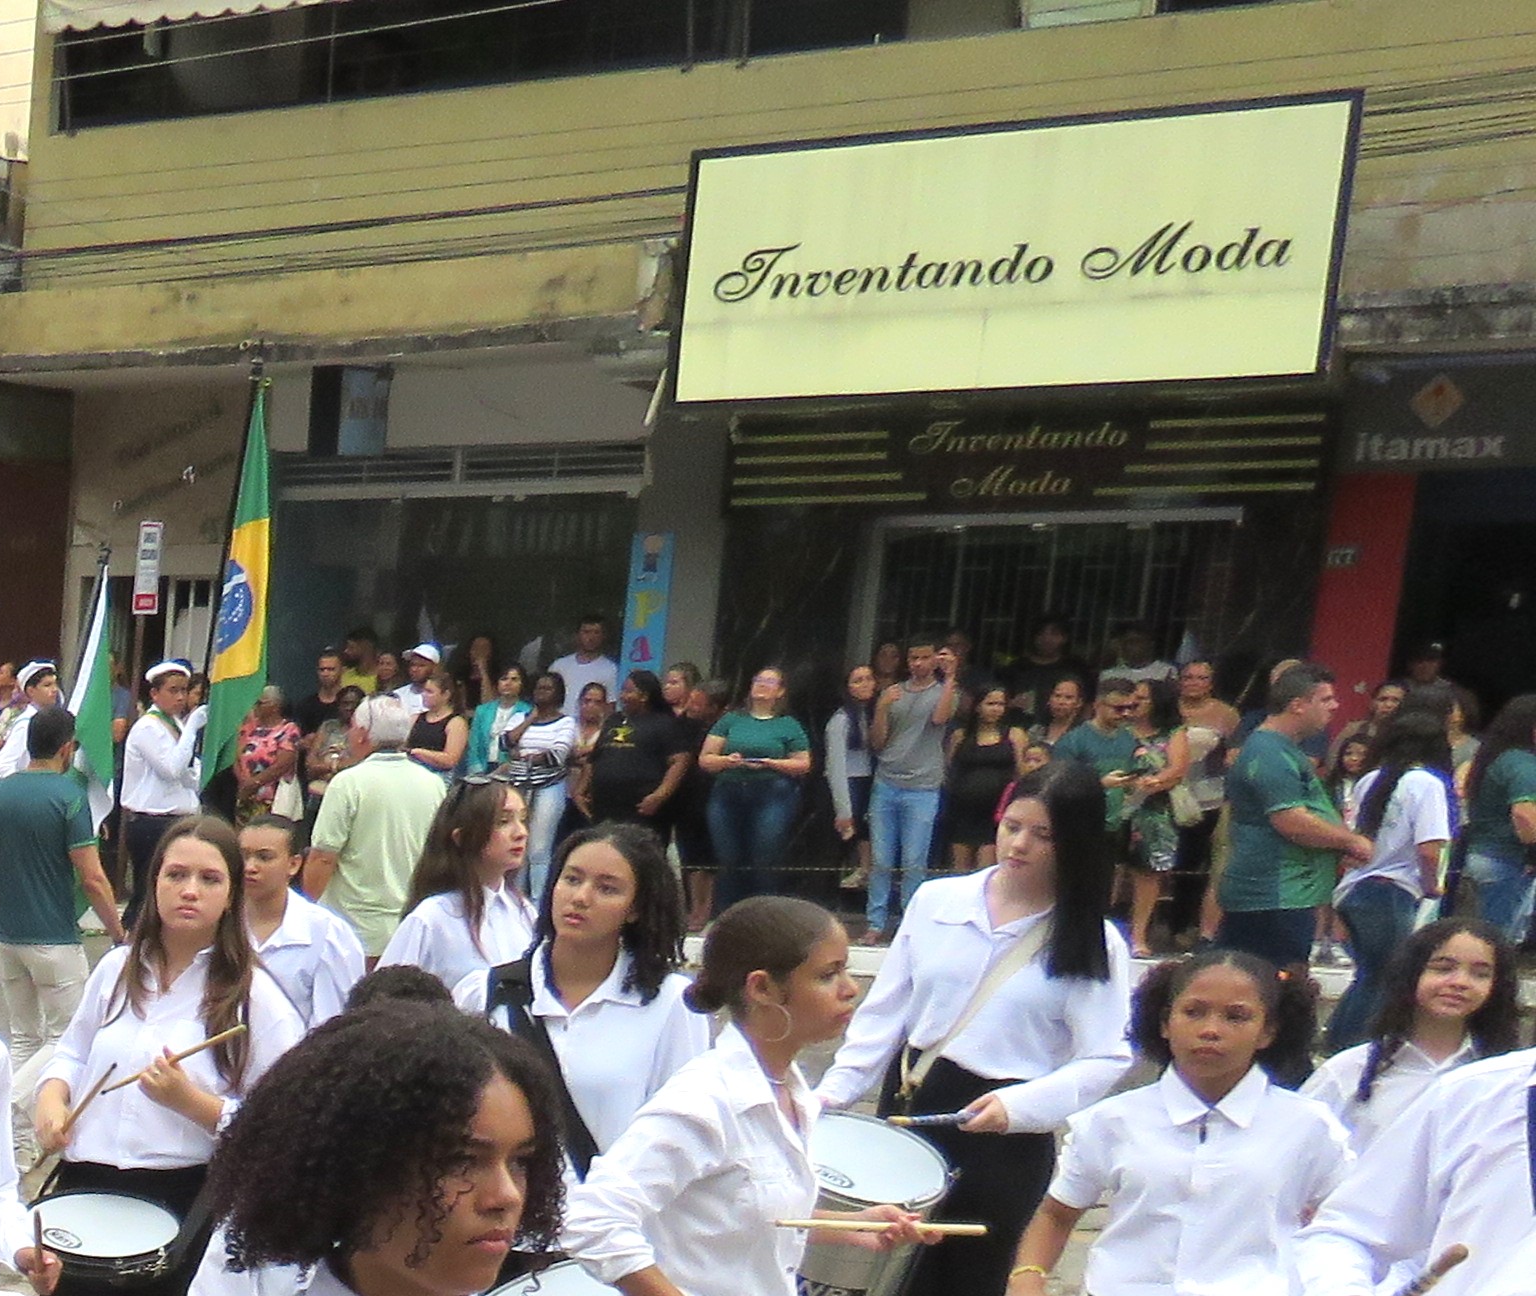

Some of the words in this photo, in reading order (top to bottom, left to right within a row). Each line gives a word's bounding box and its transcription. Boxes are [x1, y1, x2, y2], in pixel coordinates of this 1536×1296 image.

[713, 243, 1055, 303] Inventando
[1080, 220, 1294, 280] Moda
[908, 418, 1130, 456] Inventando
[1354, 431, 1506, 463] itamax
[950, 465, 1073, 498] Moda
